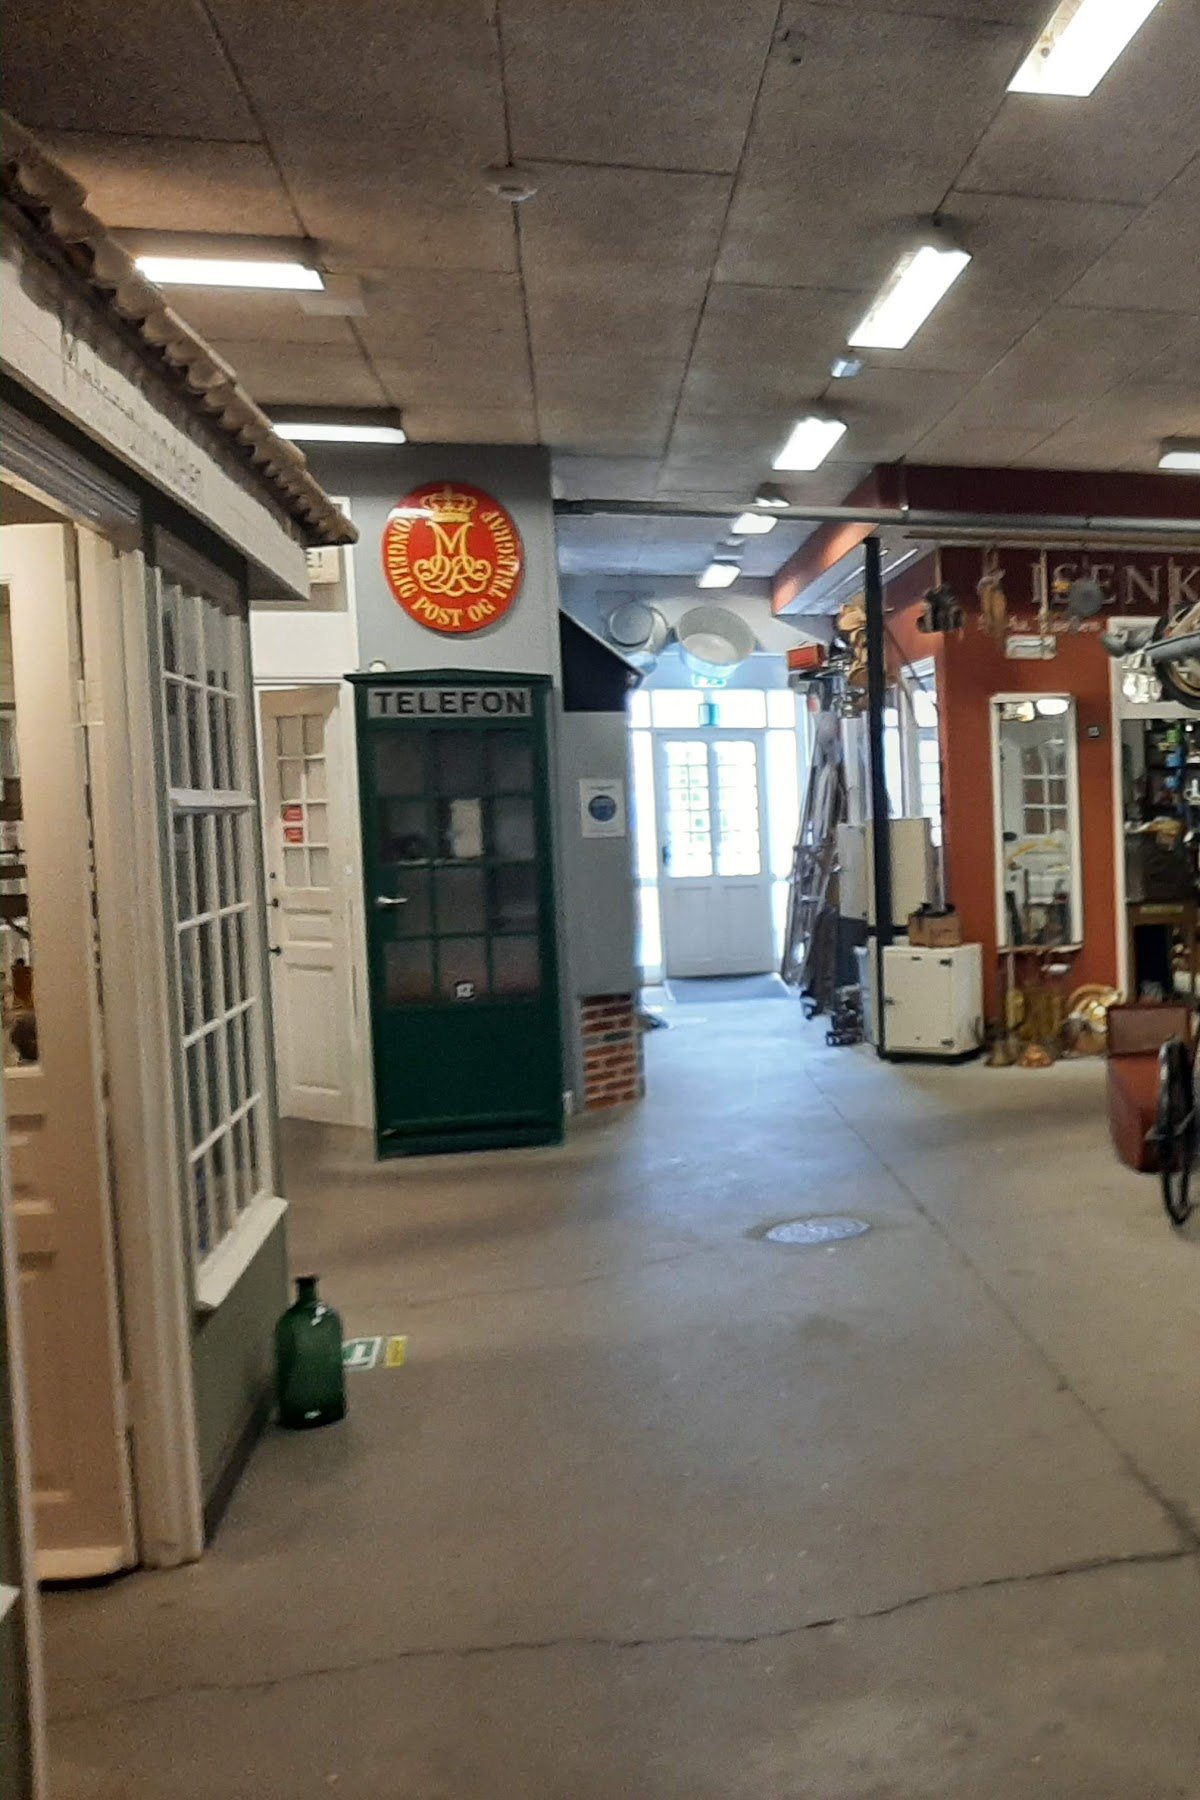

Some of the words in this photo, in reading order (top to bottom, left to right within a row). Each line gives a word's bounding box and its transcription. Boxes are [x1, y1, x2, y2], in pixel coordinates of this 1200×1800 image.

[387, 512, 419, 599] ONGELIG
[411, 596, 464, 627] POST
[467, 598, 497, 622] OG
[374, 692, 526, 714] TELEFON
